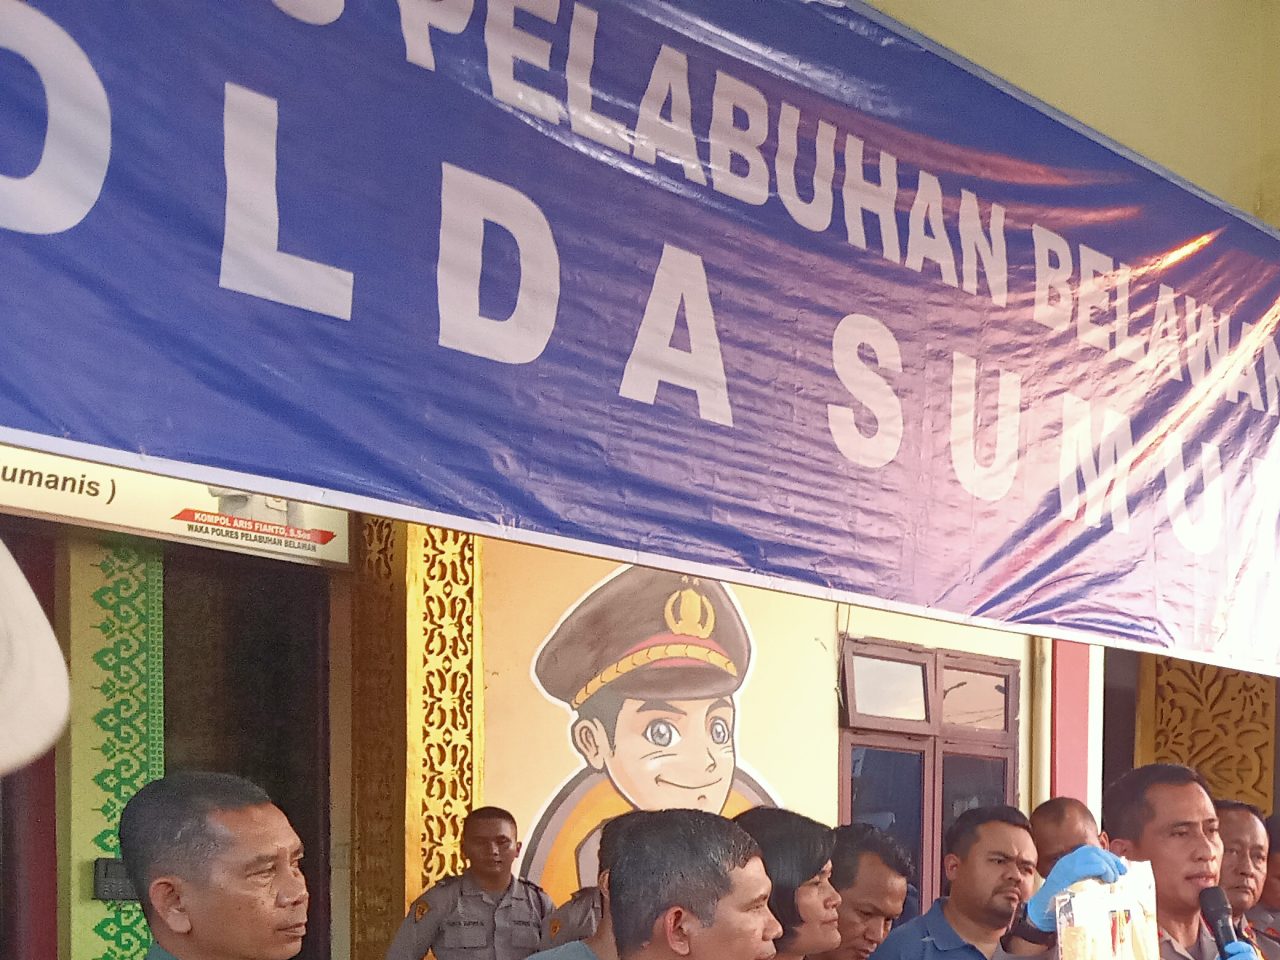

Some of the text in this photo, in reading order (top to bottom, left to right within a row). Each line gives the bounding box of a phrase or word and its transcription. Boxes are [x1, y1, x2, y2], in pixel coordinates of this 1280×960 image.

[398, 0, 1007, 308] PELABUHAN
[1, 464, 101, 497] umanis
[187, 523, 210, 534] WAKA
[211, 527, 239, 540] POLRES
[240, 532, 283, 547] PELABUHAN
[194, 512, 231, 526] KOMPOL
[233, 518, 253, 530] ARIS
